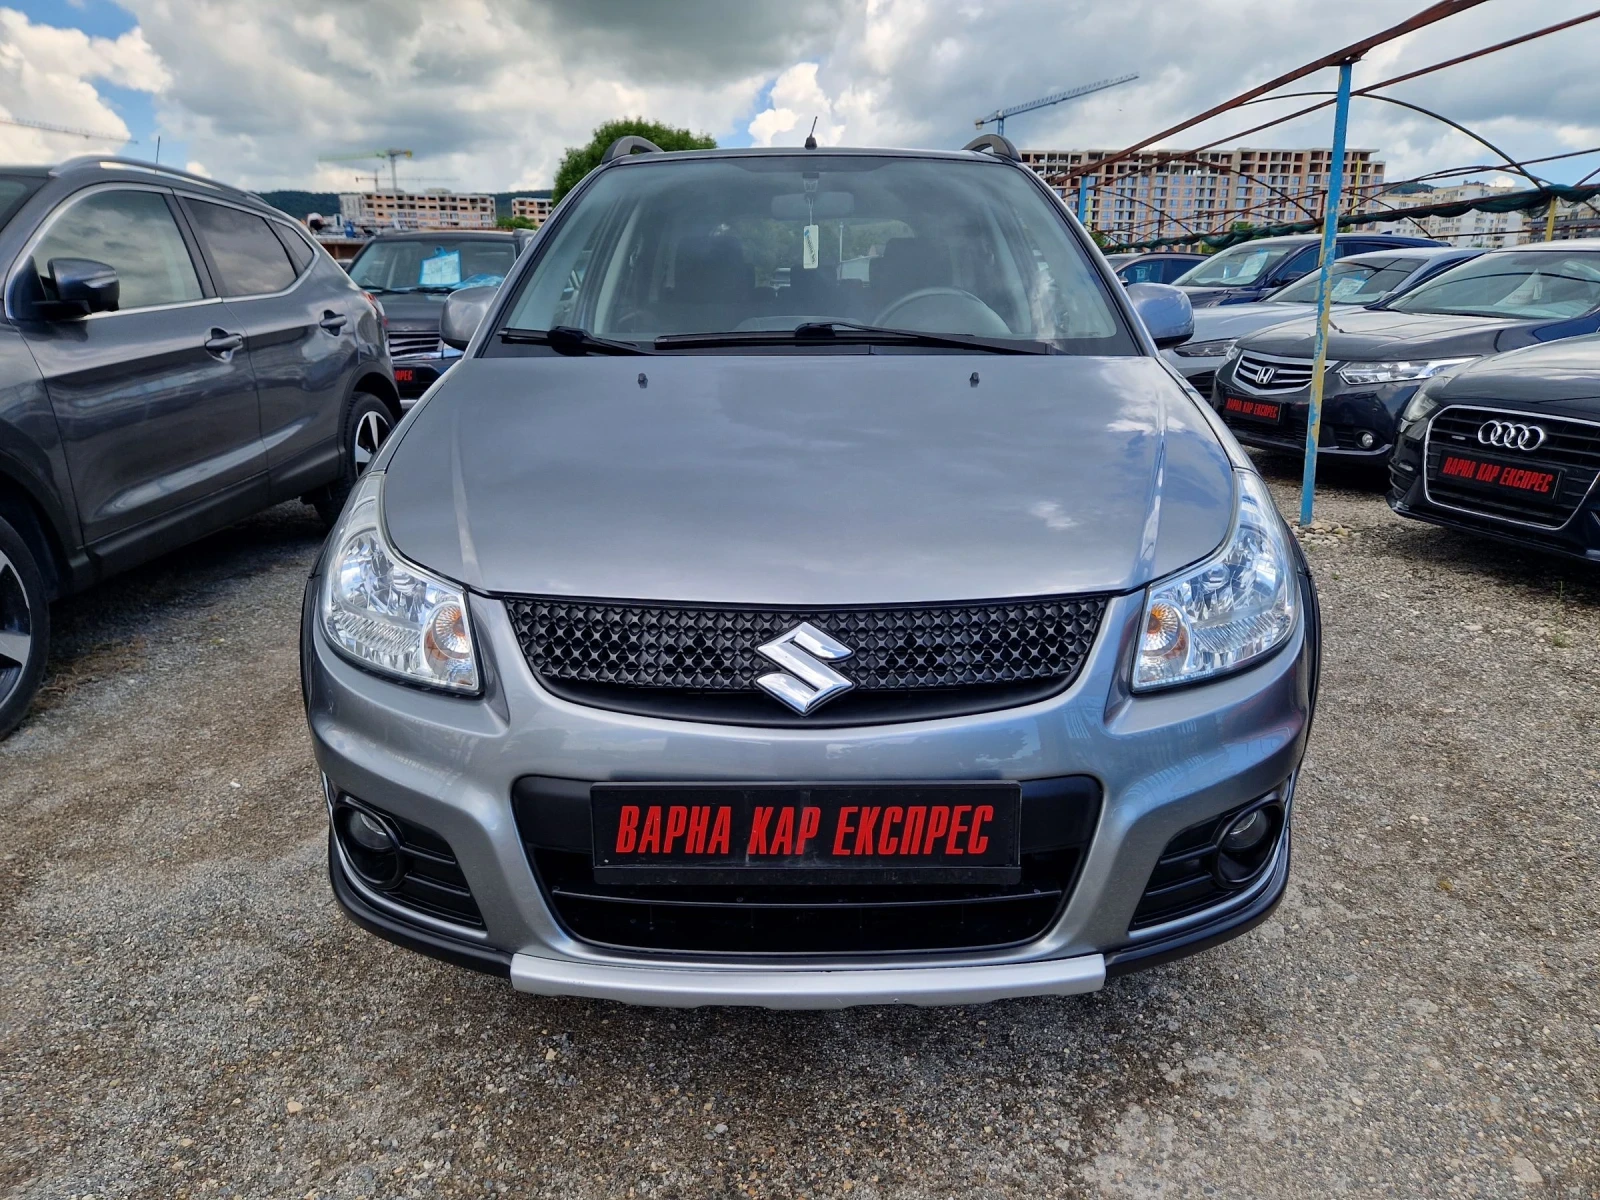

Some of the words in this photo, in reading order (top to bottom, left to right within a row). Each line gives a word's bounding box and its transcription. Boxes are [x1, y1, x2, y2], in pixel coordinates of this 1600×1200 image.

[1442, 457, 1477, 478] ВАРНА
[1476, 463, 1501, 482] КАР
[1499, 467, 1554, 493] ЕКСПРЕС
[615, 805, 733, 855] ВАРНА
[747, 805, 821, 856] КАР
[831, 804, 995, 857] ЕКСПРЕС
